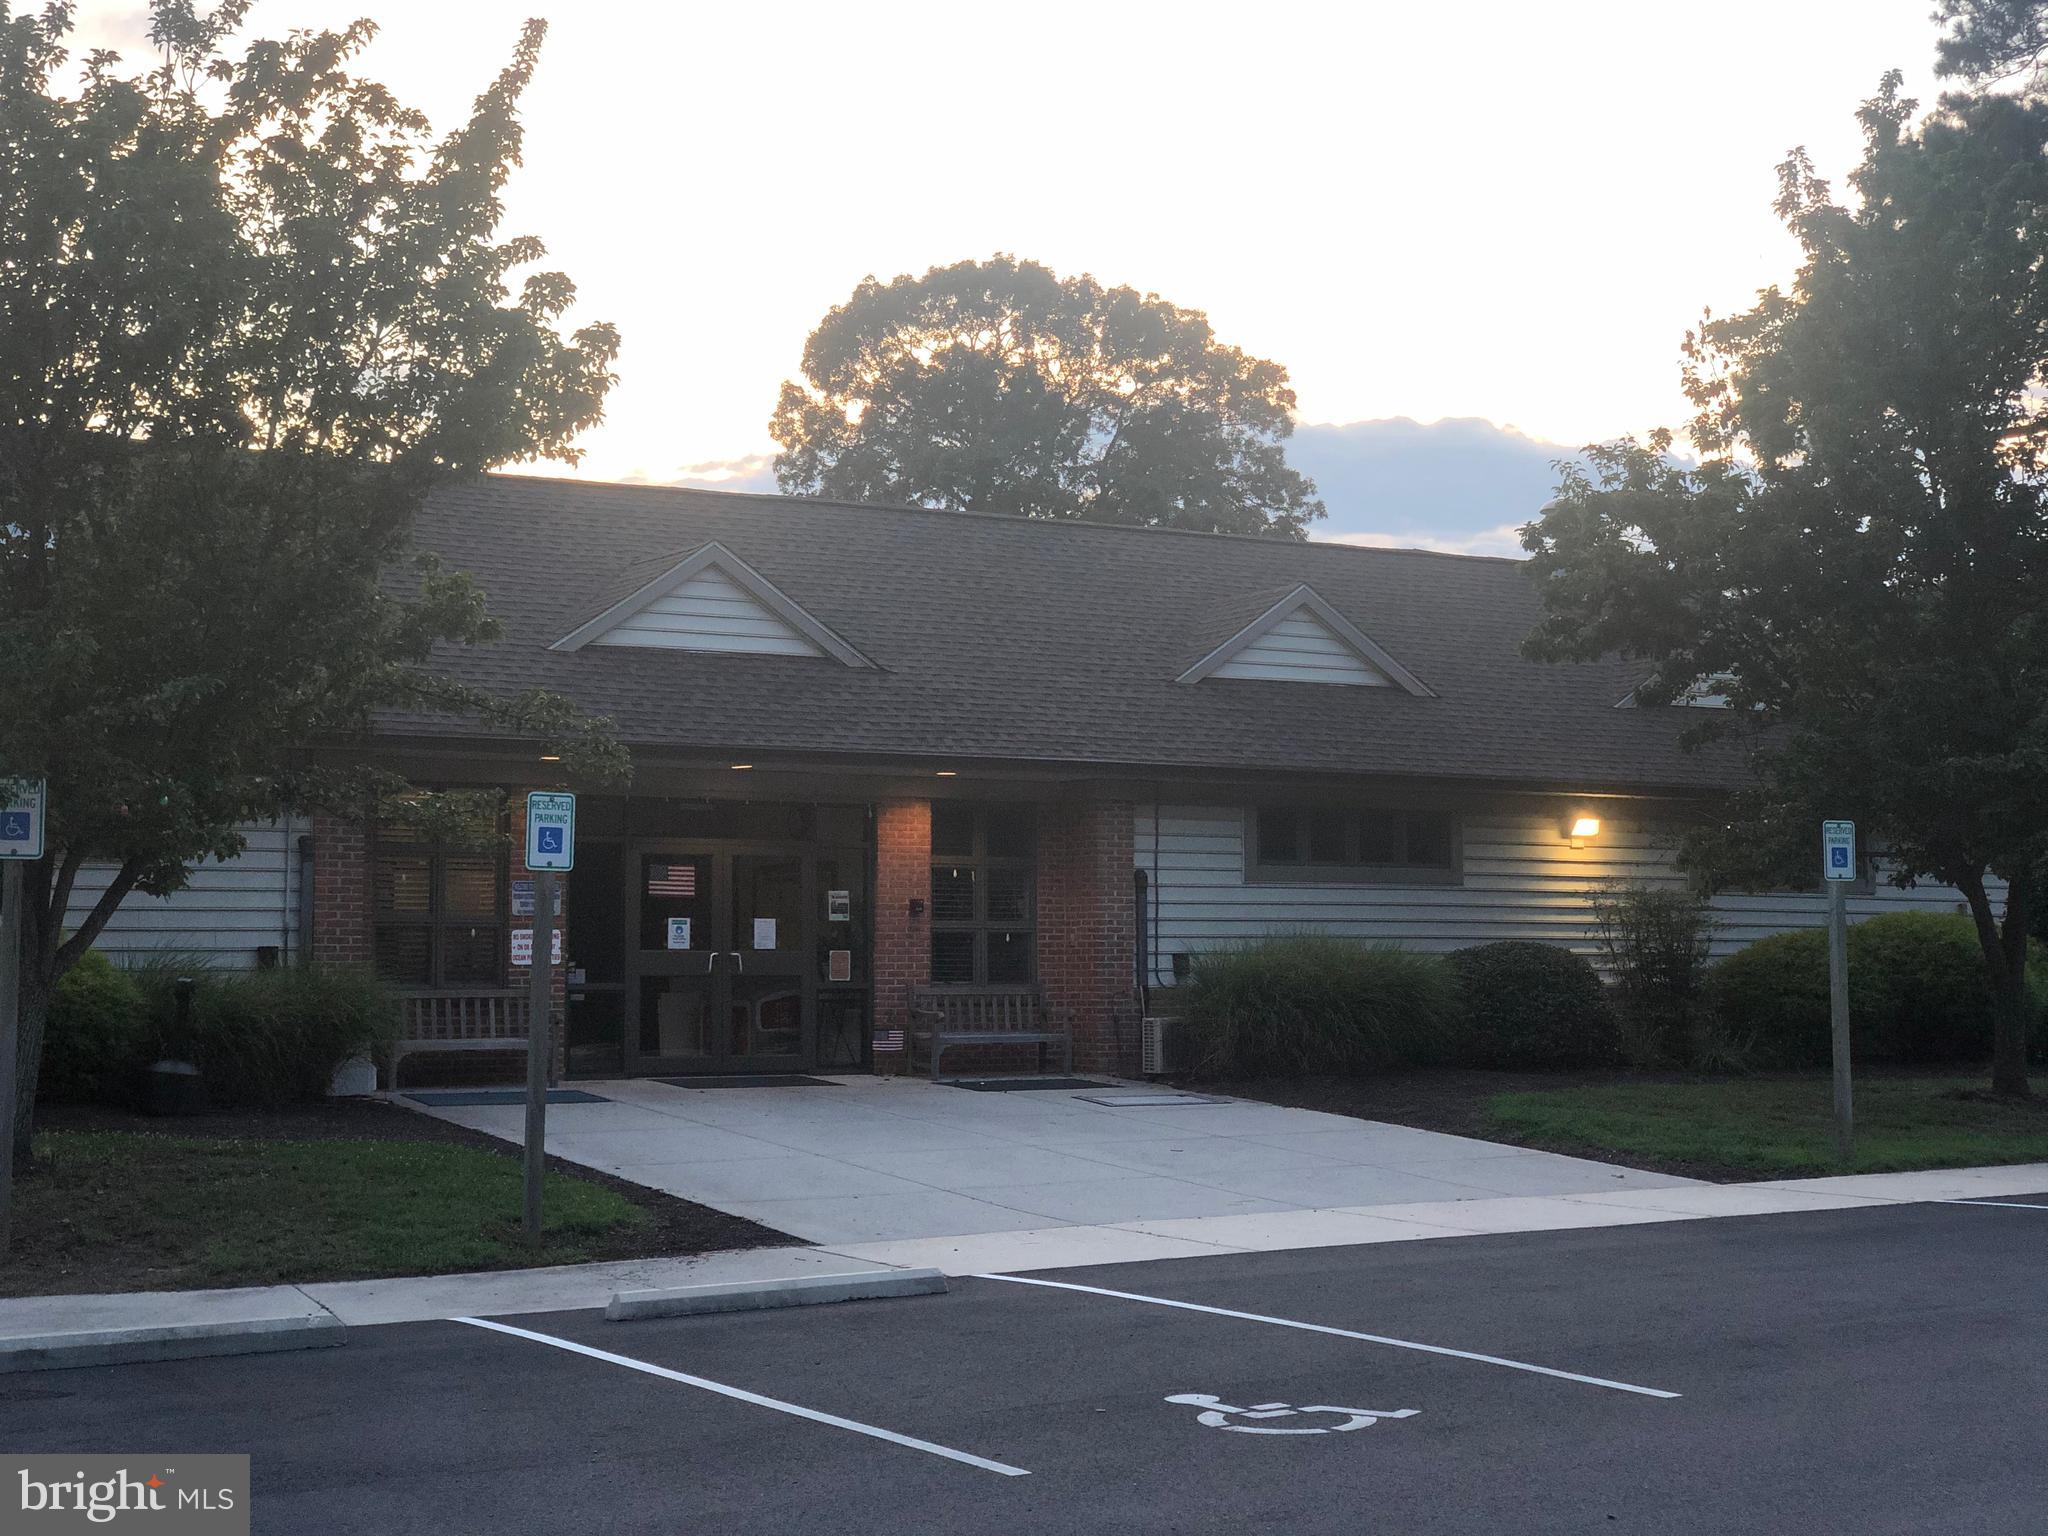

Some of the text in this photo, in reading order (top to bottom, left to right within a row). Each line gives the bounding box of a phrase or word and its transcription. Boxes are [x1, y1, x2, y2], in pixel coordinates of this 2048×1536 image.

[532, 800, 571, 811] RESERVED
[534, 813, 568, 824] PARKING
[1826, 826, 1852, 835] RESERVED
